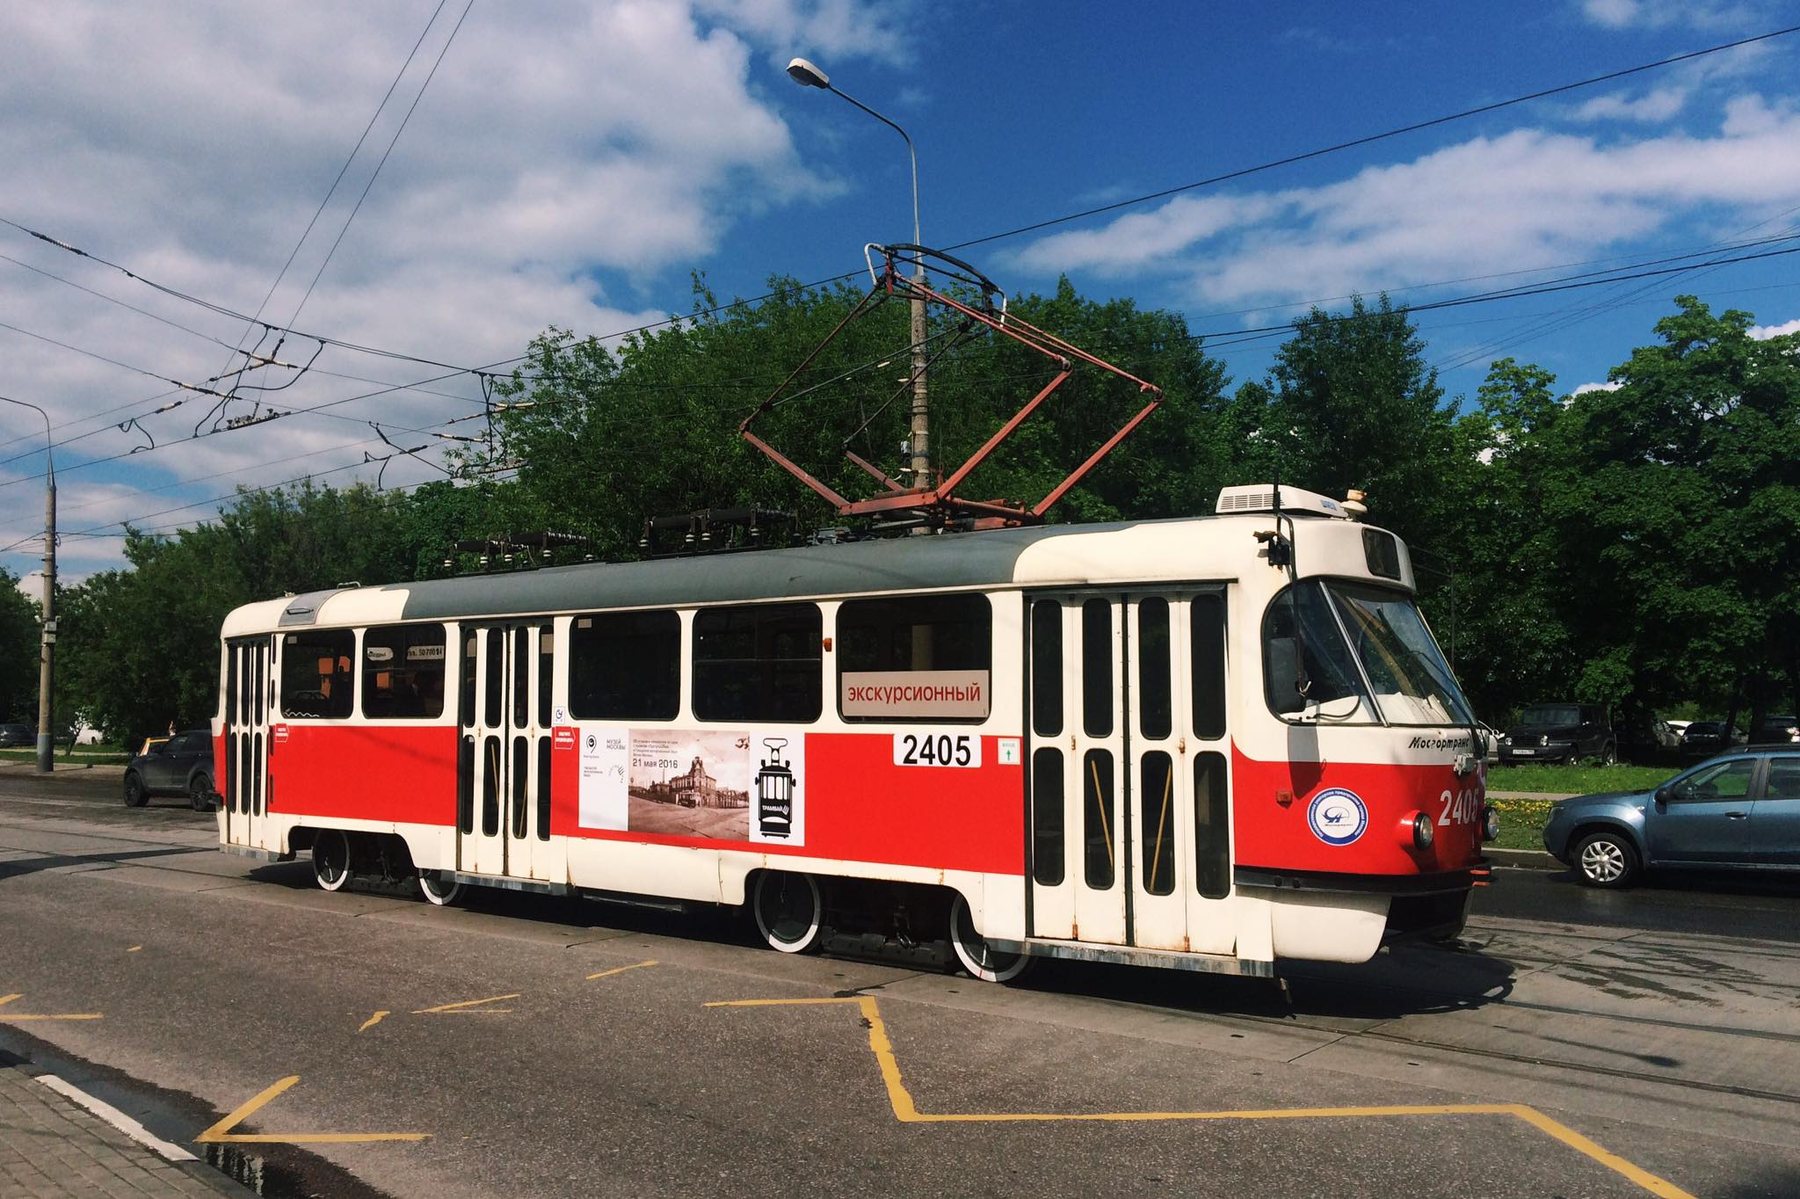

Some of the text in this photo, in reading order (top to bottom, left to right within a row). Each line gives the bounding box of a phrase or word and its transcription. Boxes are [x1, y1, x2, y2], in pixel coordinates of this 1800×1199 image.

[848, 682, 981, 704] экскурсионный
[902, 734, 971, 766] 2405
[1408, 737, 1469, 751] Мосгортранс
[632, 758, 642, 767] 21
[658, 759, 678, 768] 2016
[1437, 788, 1479, 826] 2405
